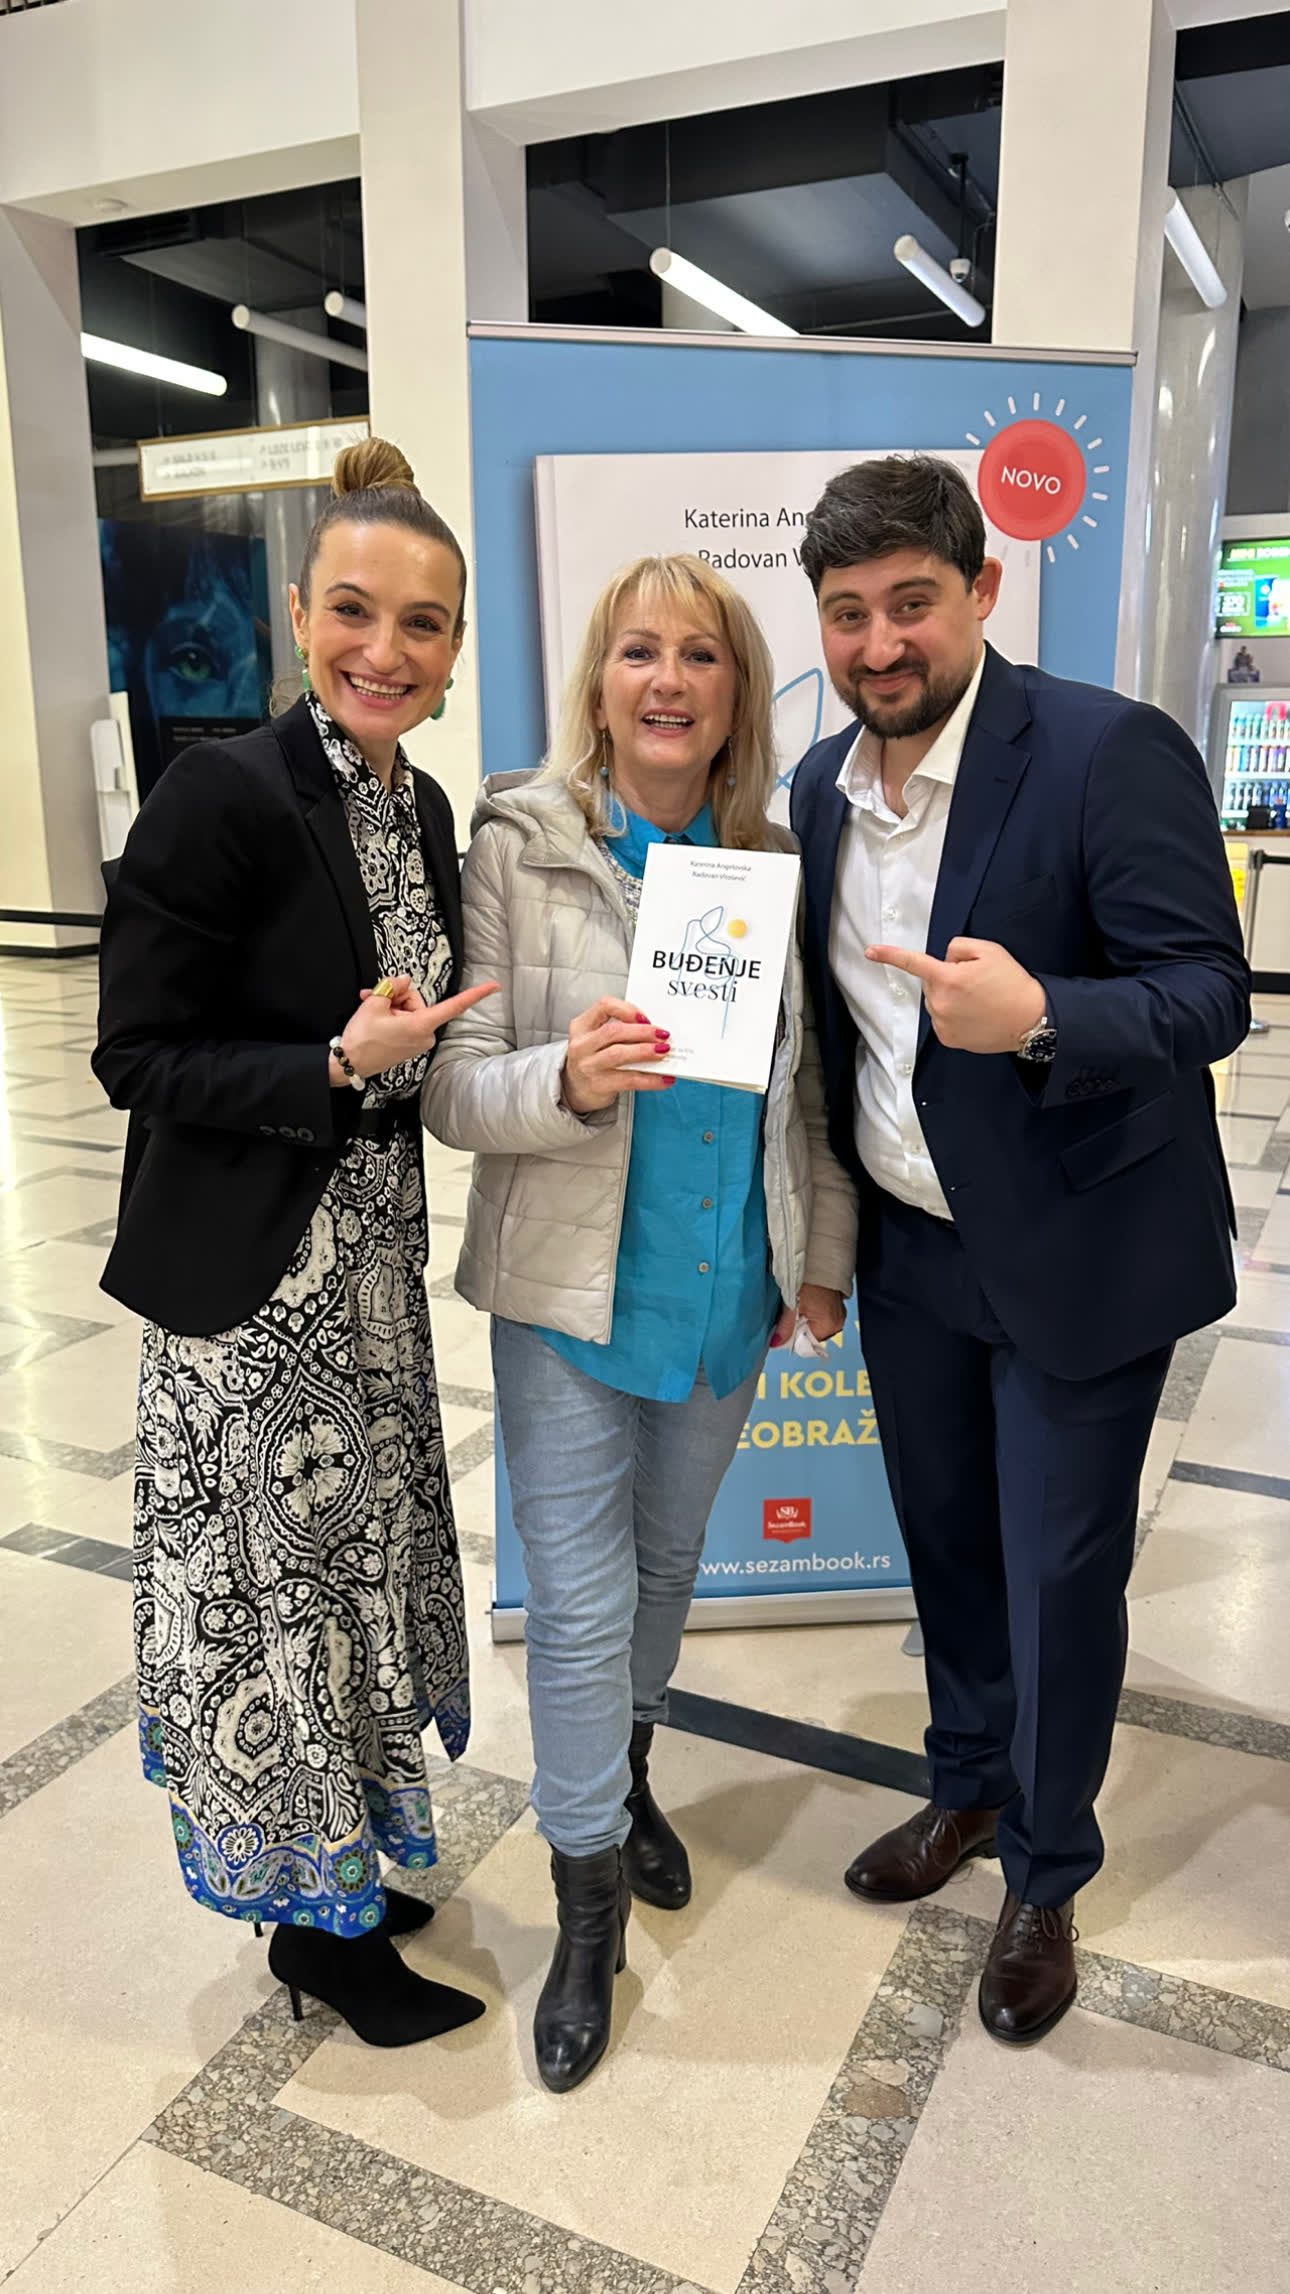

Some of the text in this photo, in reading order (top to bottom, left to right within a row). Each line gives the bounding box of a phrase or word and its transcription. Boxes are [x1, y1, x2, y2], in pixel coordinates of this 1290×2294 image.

[1001, 465, 1061, 495] NOVO
[684, 508, 770, 528] Katerina
[698, 548, 787, 569] Radovan
[652, 950, 762, 980] BUĐENJE
[667, 979, 738, 1003] svesti
[700, 1551, 891, 1576] ww.sezambook.rs
